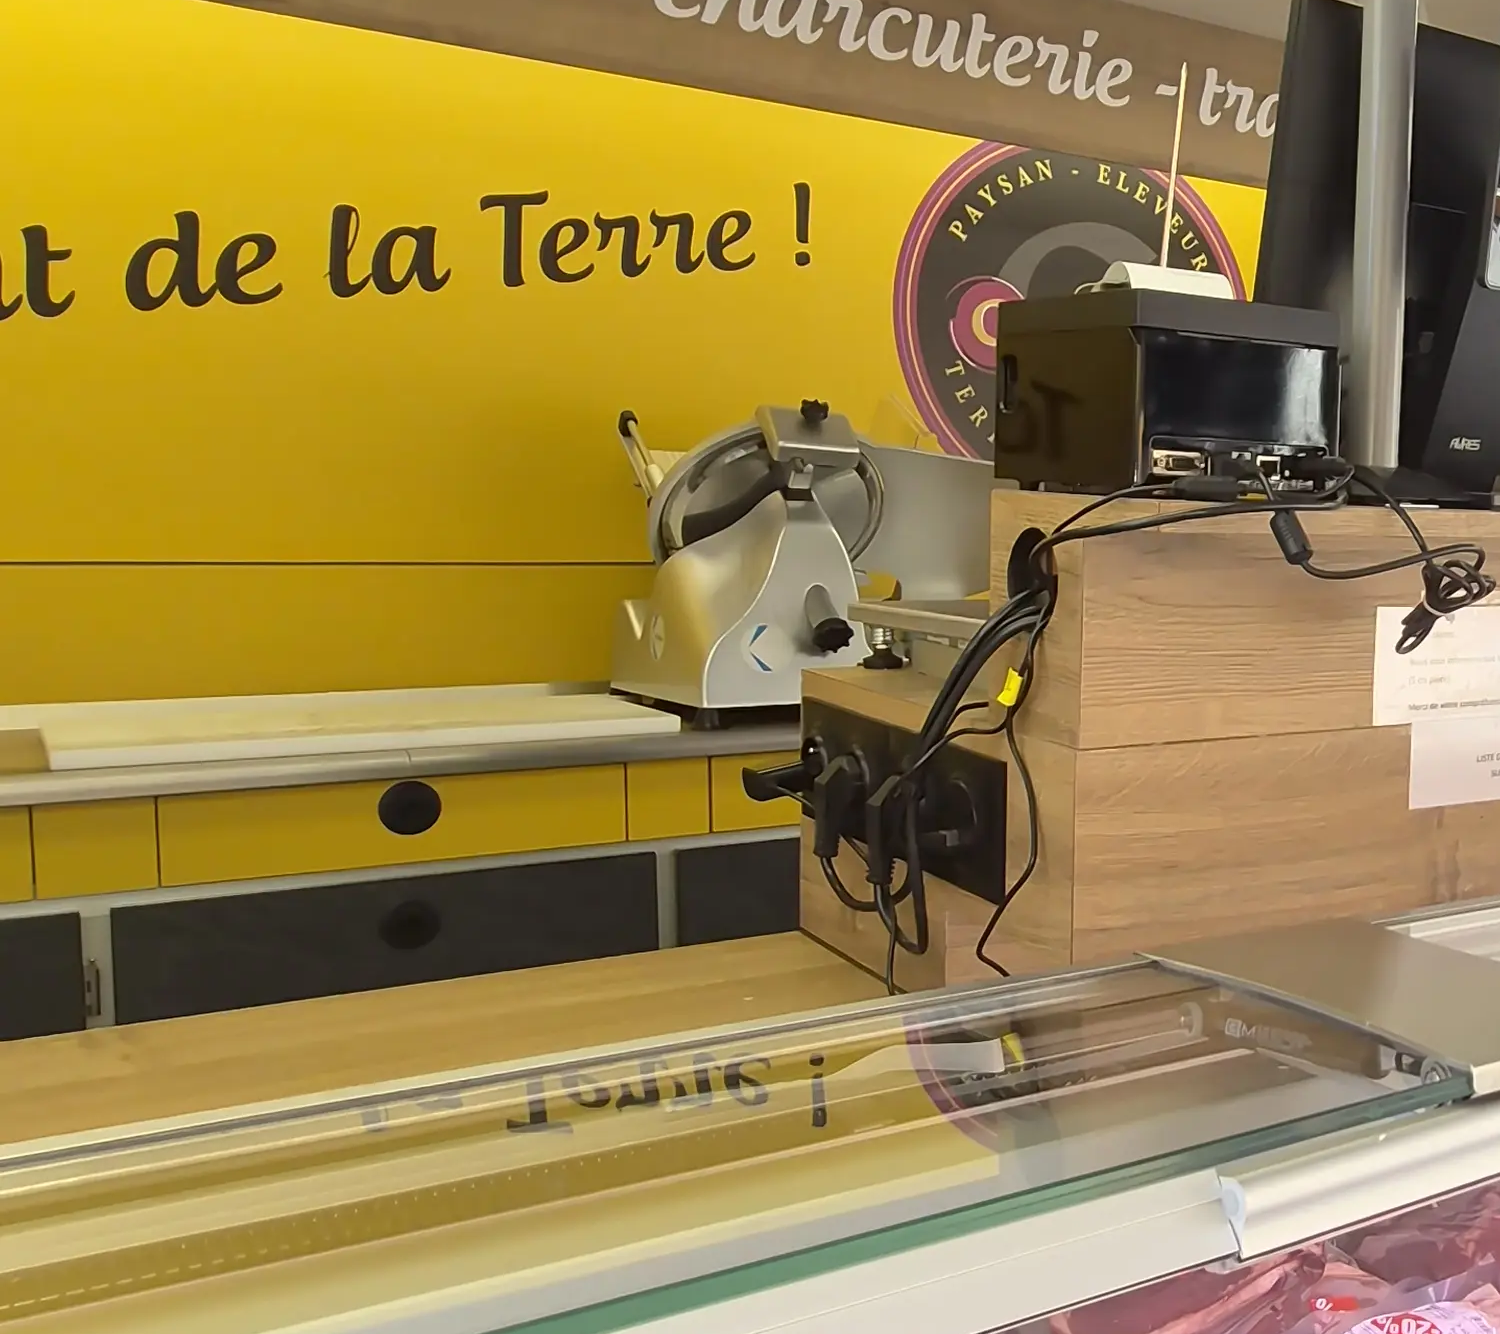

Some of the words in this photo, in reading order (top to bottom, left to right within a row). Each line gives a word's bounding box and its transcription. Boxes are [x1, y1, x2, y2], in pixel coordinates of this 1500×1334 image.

[124, 210, 284, 312] de
[322, 205, 452, 299] la
[479, 189, 757, 289] Terre
[947, 158, 1054, 243] PAYSAN
[1096, 162, 1209, 272] ELEVEUR
